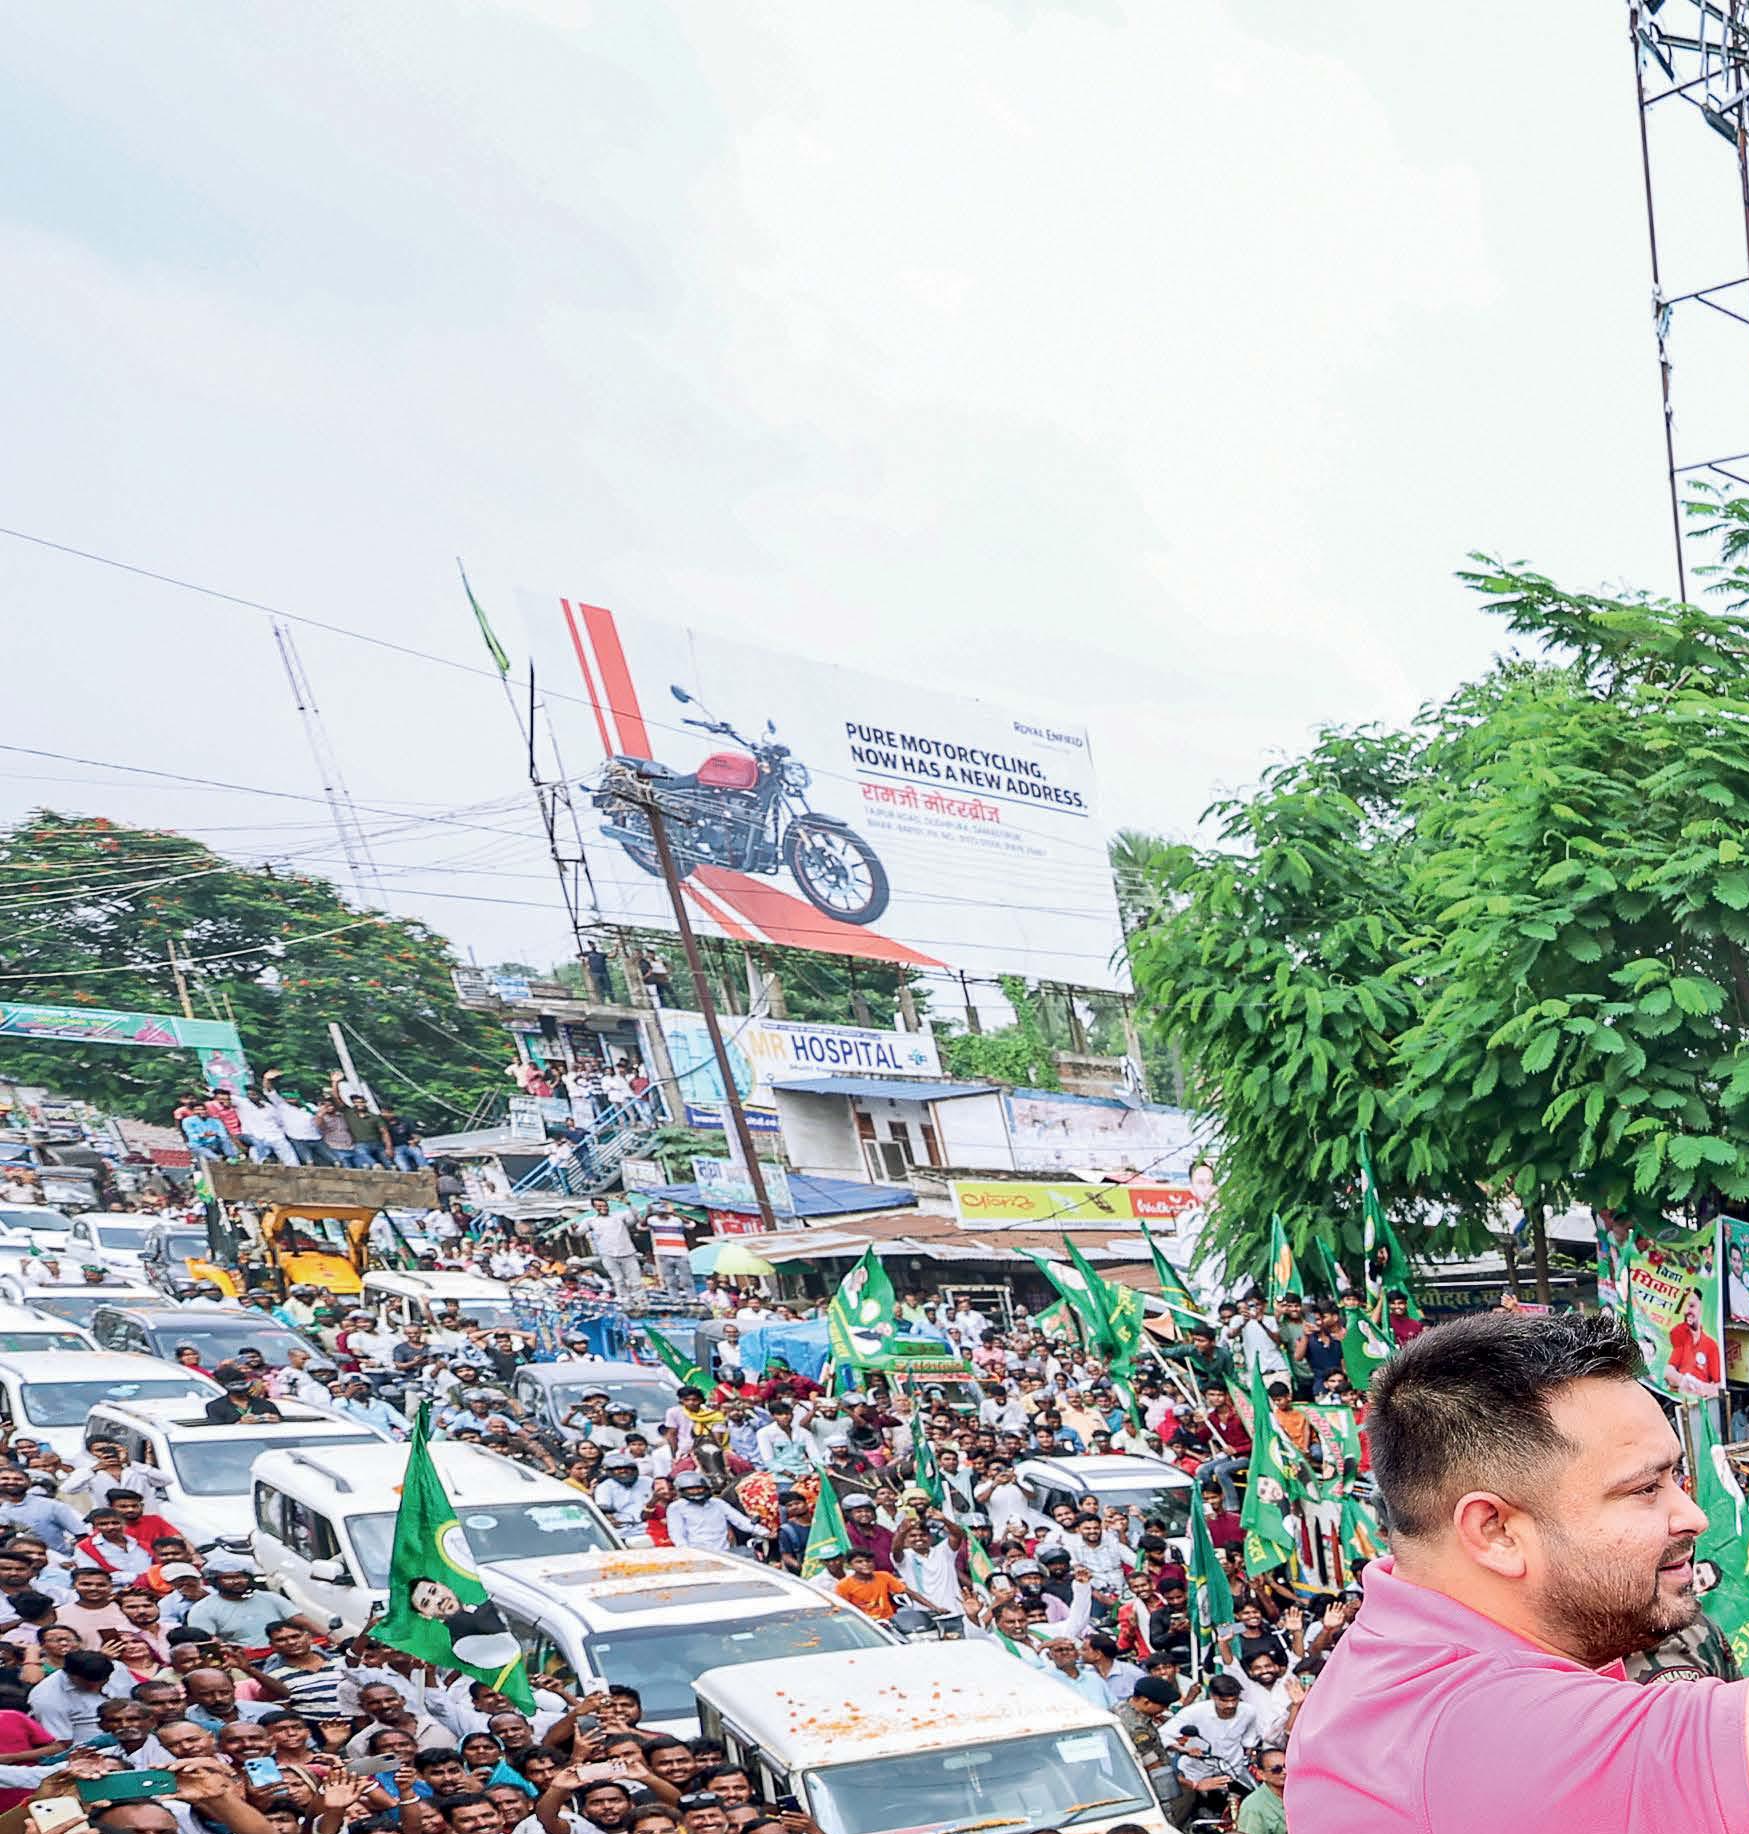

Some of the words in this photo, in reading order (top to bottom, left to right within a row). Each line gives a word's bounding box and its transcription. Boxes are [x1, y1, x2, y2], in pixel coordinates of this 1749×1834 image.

[846, 722, 897, 748] PURE
[900, 733, 1047, 780] MOTORCYCLING,
[850, 746, 897, 769] NOW
[903, 757, 940, 777] HAS
[945, 765, 957, 782] A
[961, 769, 1003, 791] NEW
[1007, 778, 1088, 809] ADDRESS.
[750, 1031, 787, 1059] MR
[792, 1035, 903, 1069] HOSPITAL
